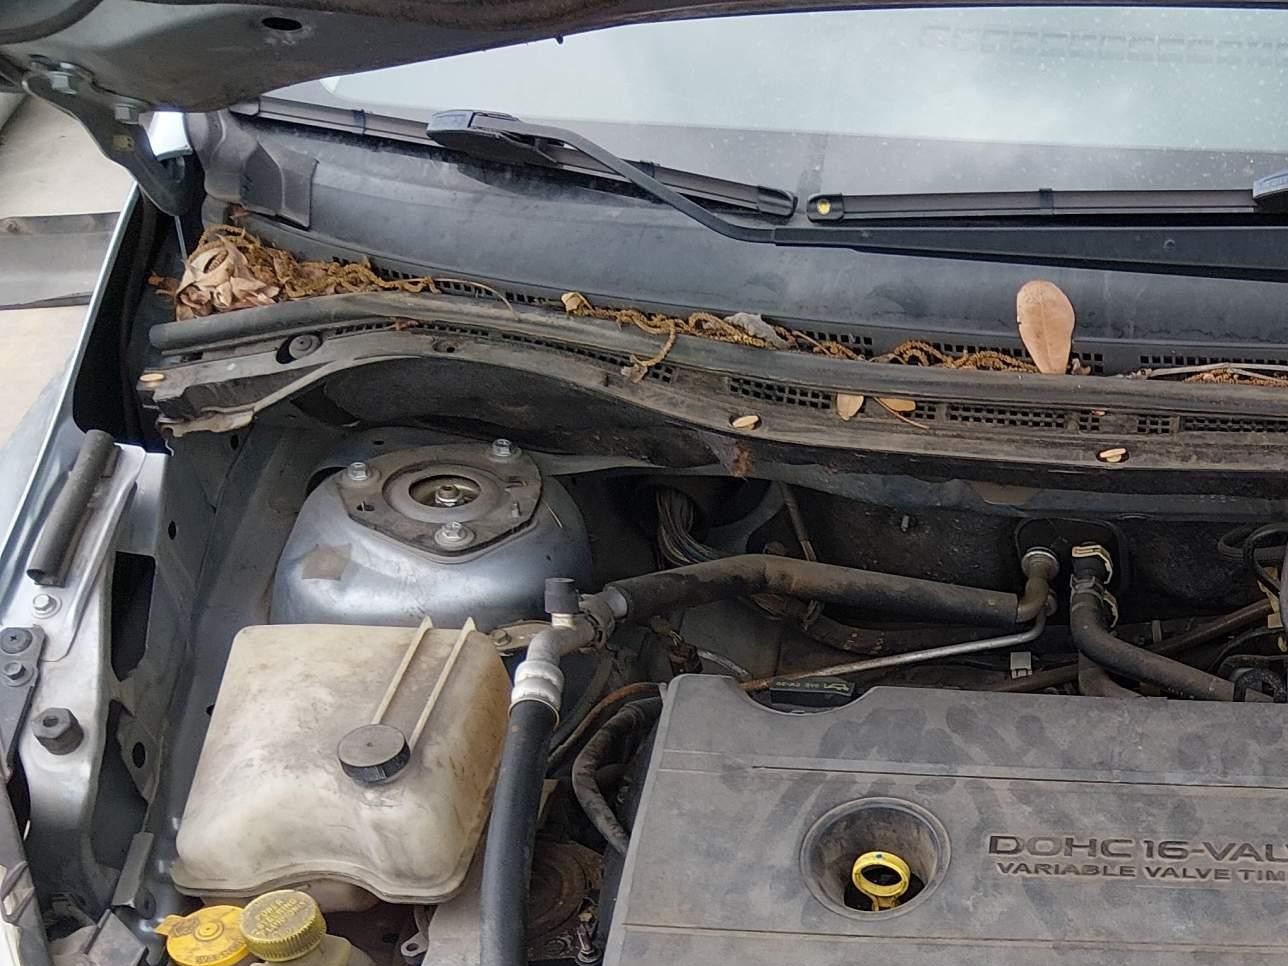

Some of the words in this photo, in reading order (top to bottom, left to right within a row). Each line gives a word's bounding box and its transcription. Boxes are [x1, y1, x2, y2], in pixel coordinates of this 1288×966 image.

[988, 835, 1133, 858] DOHC
[997, 861, 1137, 878] VARIABLE
[1144, 865, 1231, 881] VALVE
